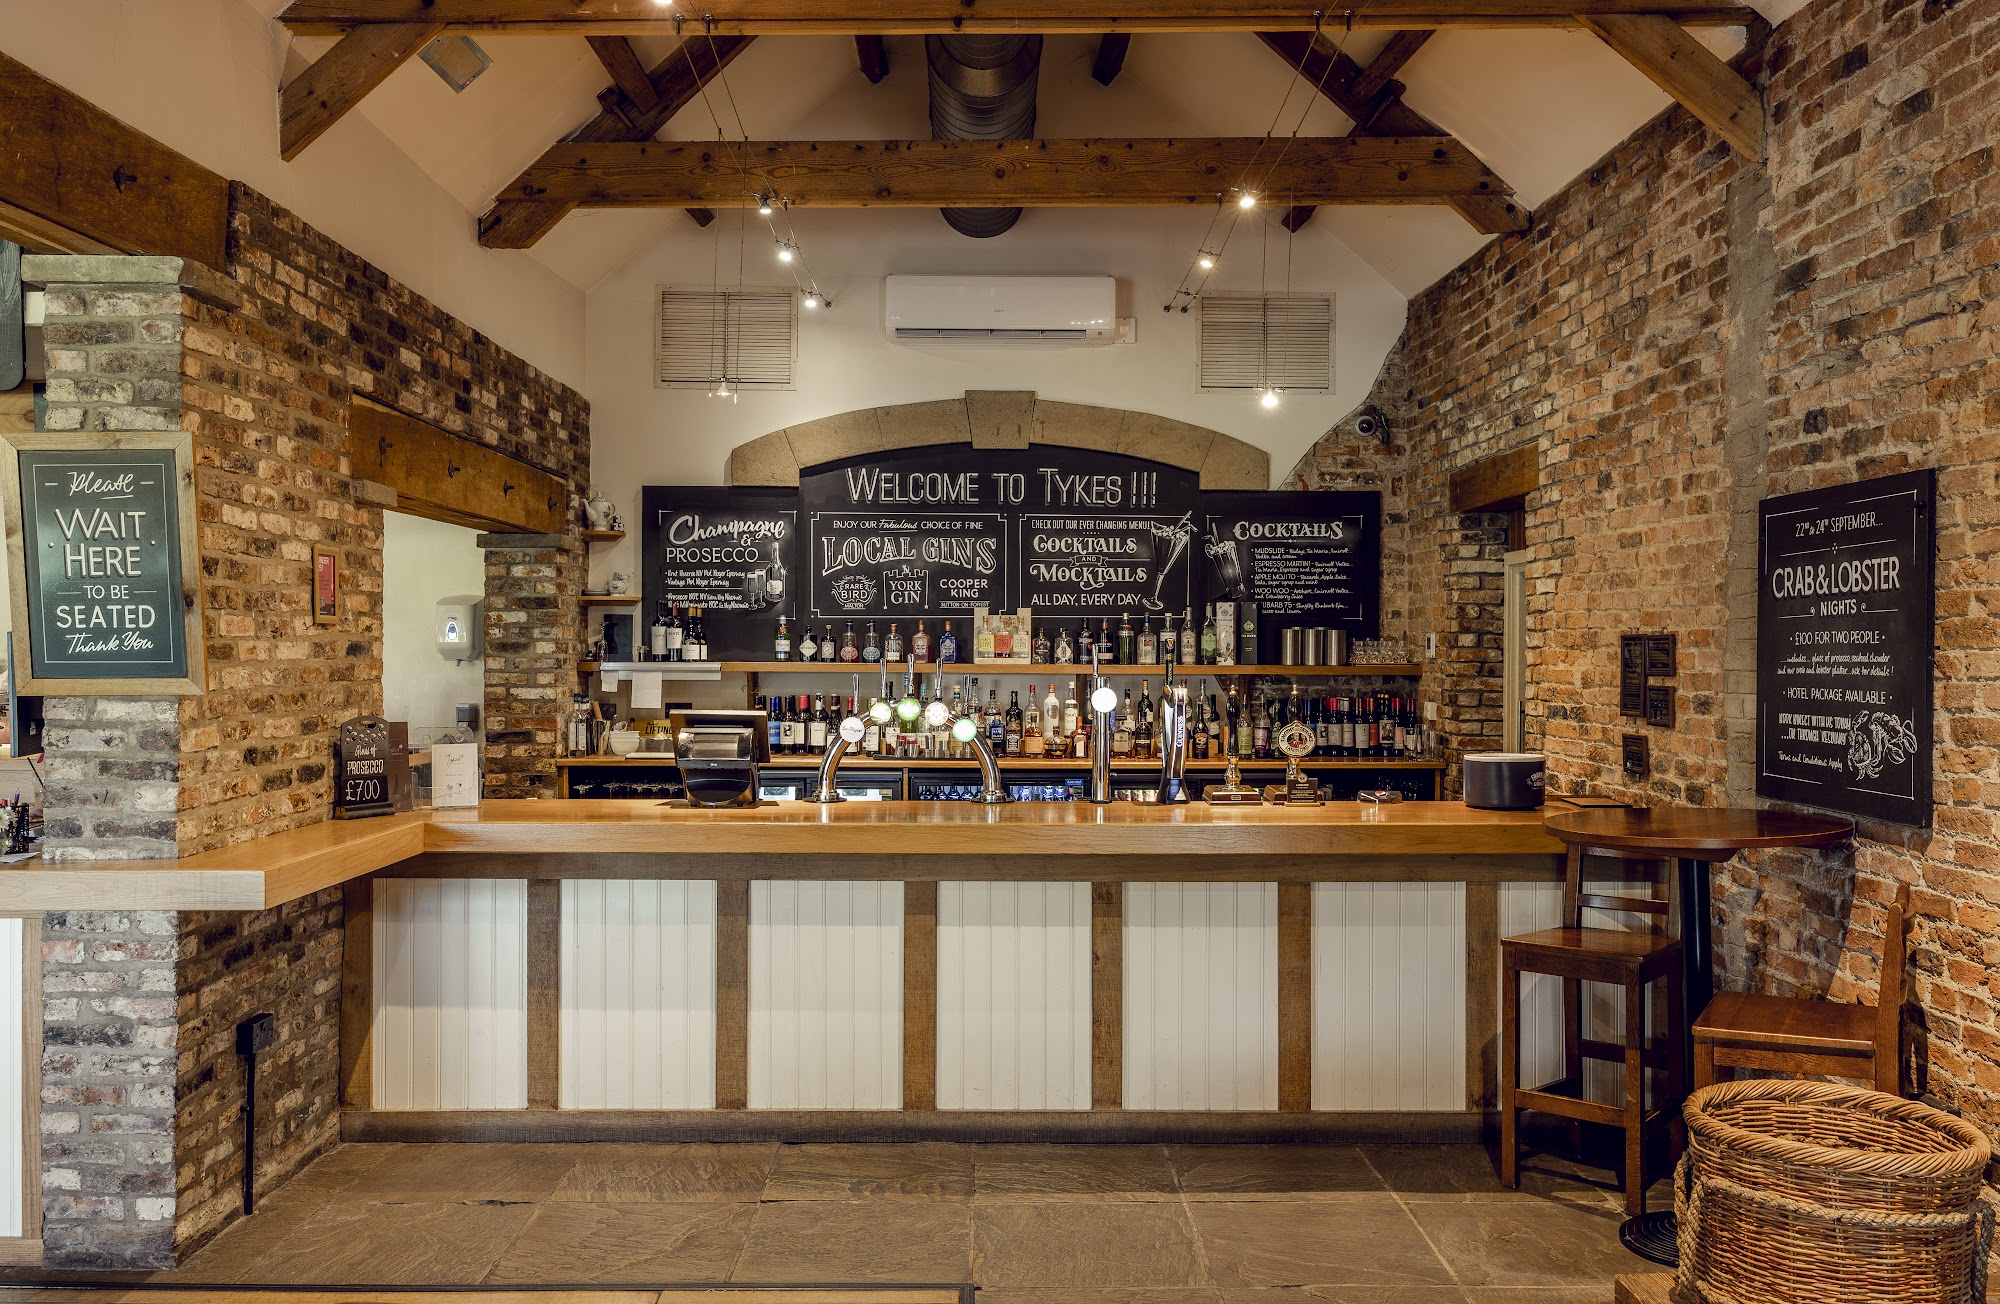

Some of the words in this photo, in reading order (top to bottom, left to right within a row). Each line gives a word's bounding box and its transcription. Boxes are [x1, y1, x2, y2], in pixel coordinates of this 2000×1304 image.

[67, 471, 134, 496] Please
[846, 468, 979, 504] WELCOME
[992, 473, 1026, 505] TO
[1037, 468, 1122, 507] TYKES
[1130, 471, 1157, 508] !!!
[54, 507, 146, 541] WAIT
[669, 514, 786, 545] Champagne
[833, 520, 858, 529] ENJOY
[860, 520, 877, 529] OUR
[878, 519, 918, 530] Fabulous
[921, 521, 950, 529] CHOICE
[951, 521, 962, 529] OF
[965, 521, 983, 529] FINE
[1032, 520, 1051, 529] CHECK
[1052, 520, 1064, 529] OUT
[1066, 520, 1077, 529] OUR
[1079, 520, 1094, 529] EVER
[1096, 520, 1127, 530] CHANGING
[1129, 520, 1150, 530] MENU!
[1232, 520, 1344, 540] COCKTAILS
[1831, 512, 1883, 532] SEPTEMBER...
[740, 534, 754, 546] &
[1033, 534, 1137, 554] COCKTAILS
[64, 543, 141, 579] HERE
[666, 547, 759, 562] PROSECCO
[822, 537, 917, 576] LOCAL
[922, 537, 997, 574] GINS
[889, 580, 922, 590] YORK
[940, 578, 988, 588] COOPER
[1030, 564, 1147, 590] MOCKTAILS
[1772, 565, 1814, 598] CRAB
[1816, 564, 1829, 594] &
[1831, 556, 1900, 594] LOBSTER
[83, 585, 105, 599] TO
[110, 585, 130, 599] BE
[841, 590, 868, 599] BIRD
[890, 590, 921, 604] GIN
[950, 588, 979, 598] KING
[1031, 594, 1050, 605] ALL
[1053, 594, 1078, 606] DAY,
[1081, 594, 1115, 605] EVERY
[1117, 594, 1141, 605] DAY
[56, 605, 156, 629] SEATED
[1820, 599, 1857, 617] NIGHTS
[65, 632, 120, 654] Thank
[121, 630, 154, 650] You
[1795, 632, 1812, 645] £100
[1815, 632, 1830, 644] FOR
[1832, 631, 1849, 644] TWO
[1851, 631, 1879, 644] PEOPLE
[1777, 665, 1786, 674] and
[1787, 688, 1808, 700] HOTEL
[1811, 689, 1842, 701] PACKAGE
[1845, 690, 1886, 704] AVAILABLE
[1176, 716, 1184, 747] GUINNESS
[347, 760, 383, 775] PROSECCO
[346, 780, 380, 801] £7.00
